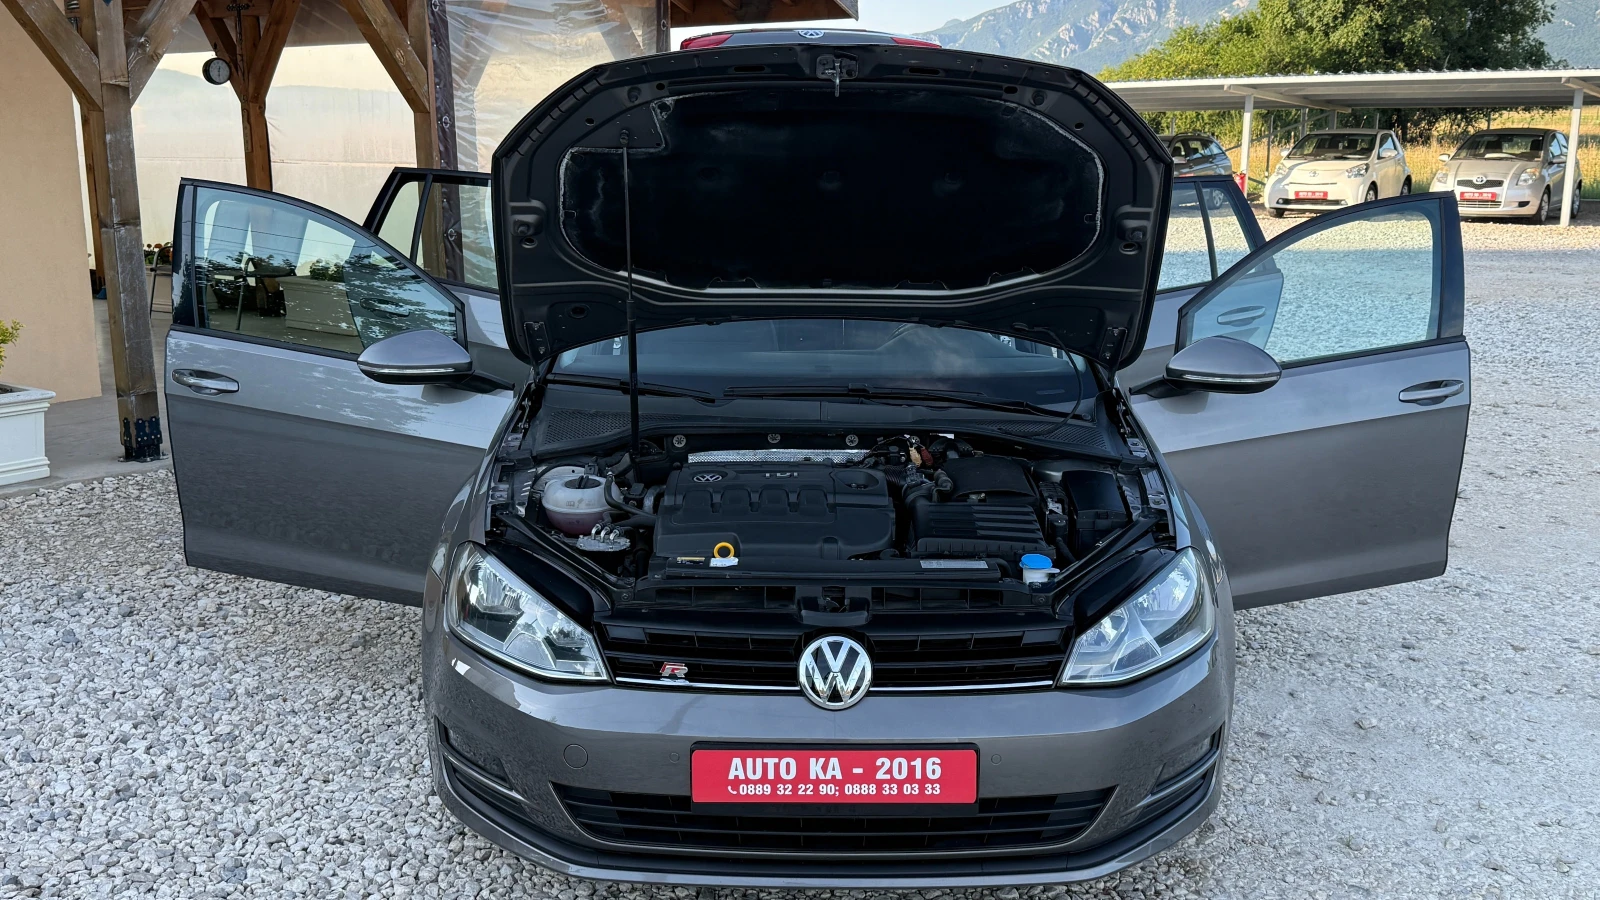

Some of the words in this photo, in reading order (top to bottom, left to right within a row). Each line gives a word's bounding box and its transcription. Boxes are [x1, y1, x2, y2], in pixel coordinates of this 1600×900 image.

[660, 662, 688, 678] R
[728, 757, 797, 780] AUTO
[809, 757, 843, 780] KA
[875, 757, 942, 780] 2016
[739, 784, 772, 796] 0889
[776, 784, 793, 796] 32
[797, 784, 814, 796] 22
[818, 784, 840, 797] 90;
[844, 784, 877, 796] 0888
[881, 784, 898, 796] 33
[903, 784, 920, 796] 03
[924, 784, 941, 796] 33
